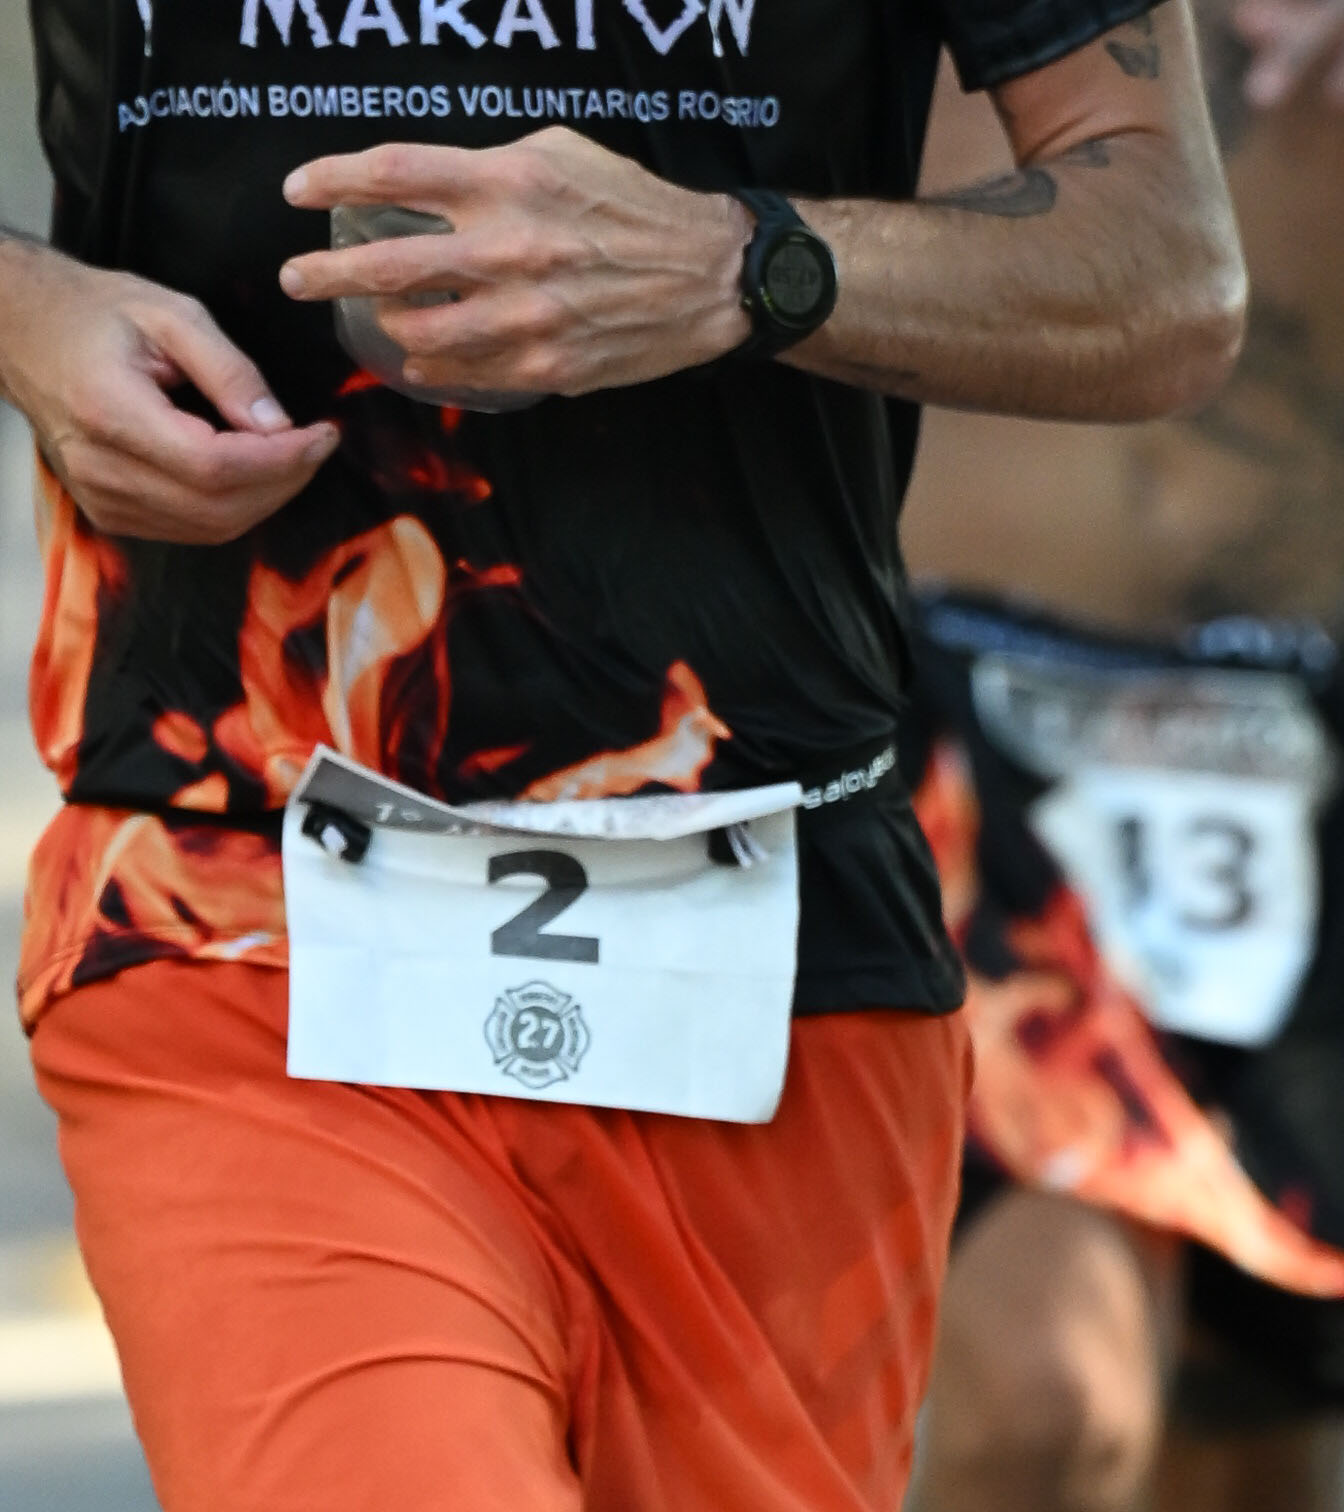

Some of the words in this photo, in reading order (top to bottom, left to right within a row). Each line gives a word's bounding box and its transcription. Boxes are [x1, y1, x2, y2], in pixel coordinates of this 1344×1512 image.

[268, 85, 452, 119] BOMBEROS
[457, 84, 671, 123] VOLUNTARIOS
[678, 89, 781, 129] ROSRIO
[487, 847, 600, 965] 2
[1113, 808, 1258, 934] 13
[516, 1010, 562, 1050] 27
